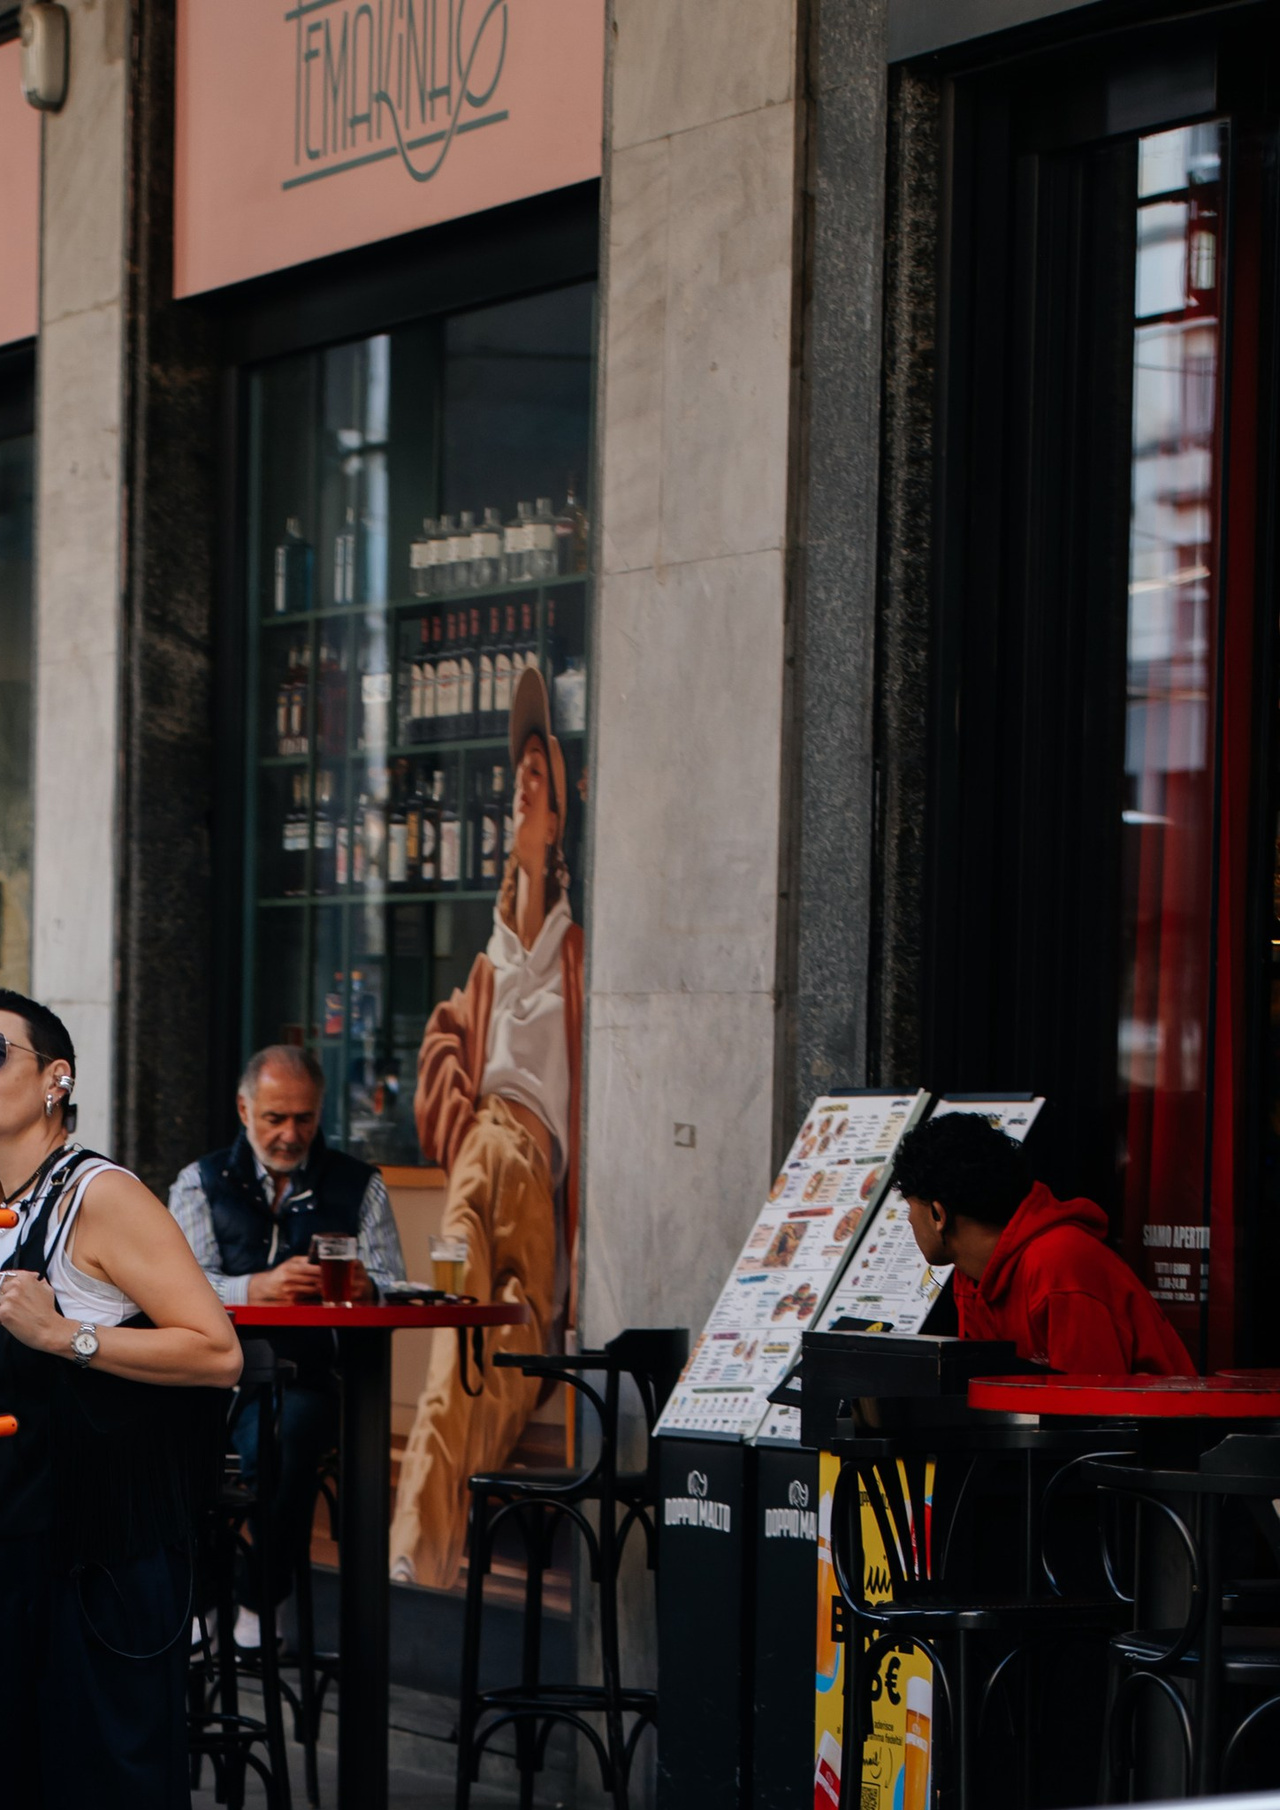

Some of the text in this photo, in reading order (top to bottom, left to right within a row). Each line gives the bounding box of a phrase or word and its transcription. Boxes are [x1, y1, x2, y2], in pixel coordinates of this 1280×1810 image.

[1143, 1224, 1172, 1248] SIAMO
[665, 1498, 731, 1533] DOPPIO MALTO
[765, 1509, 799, 1538] DOPPIO
